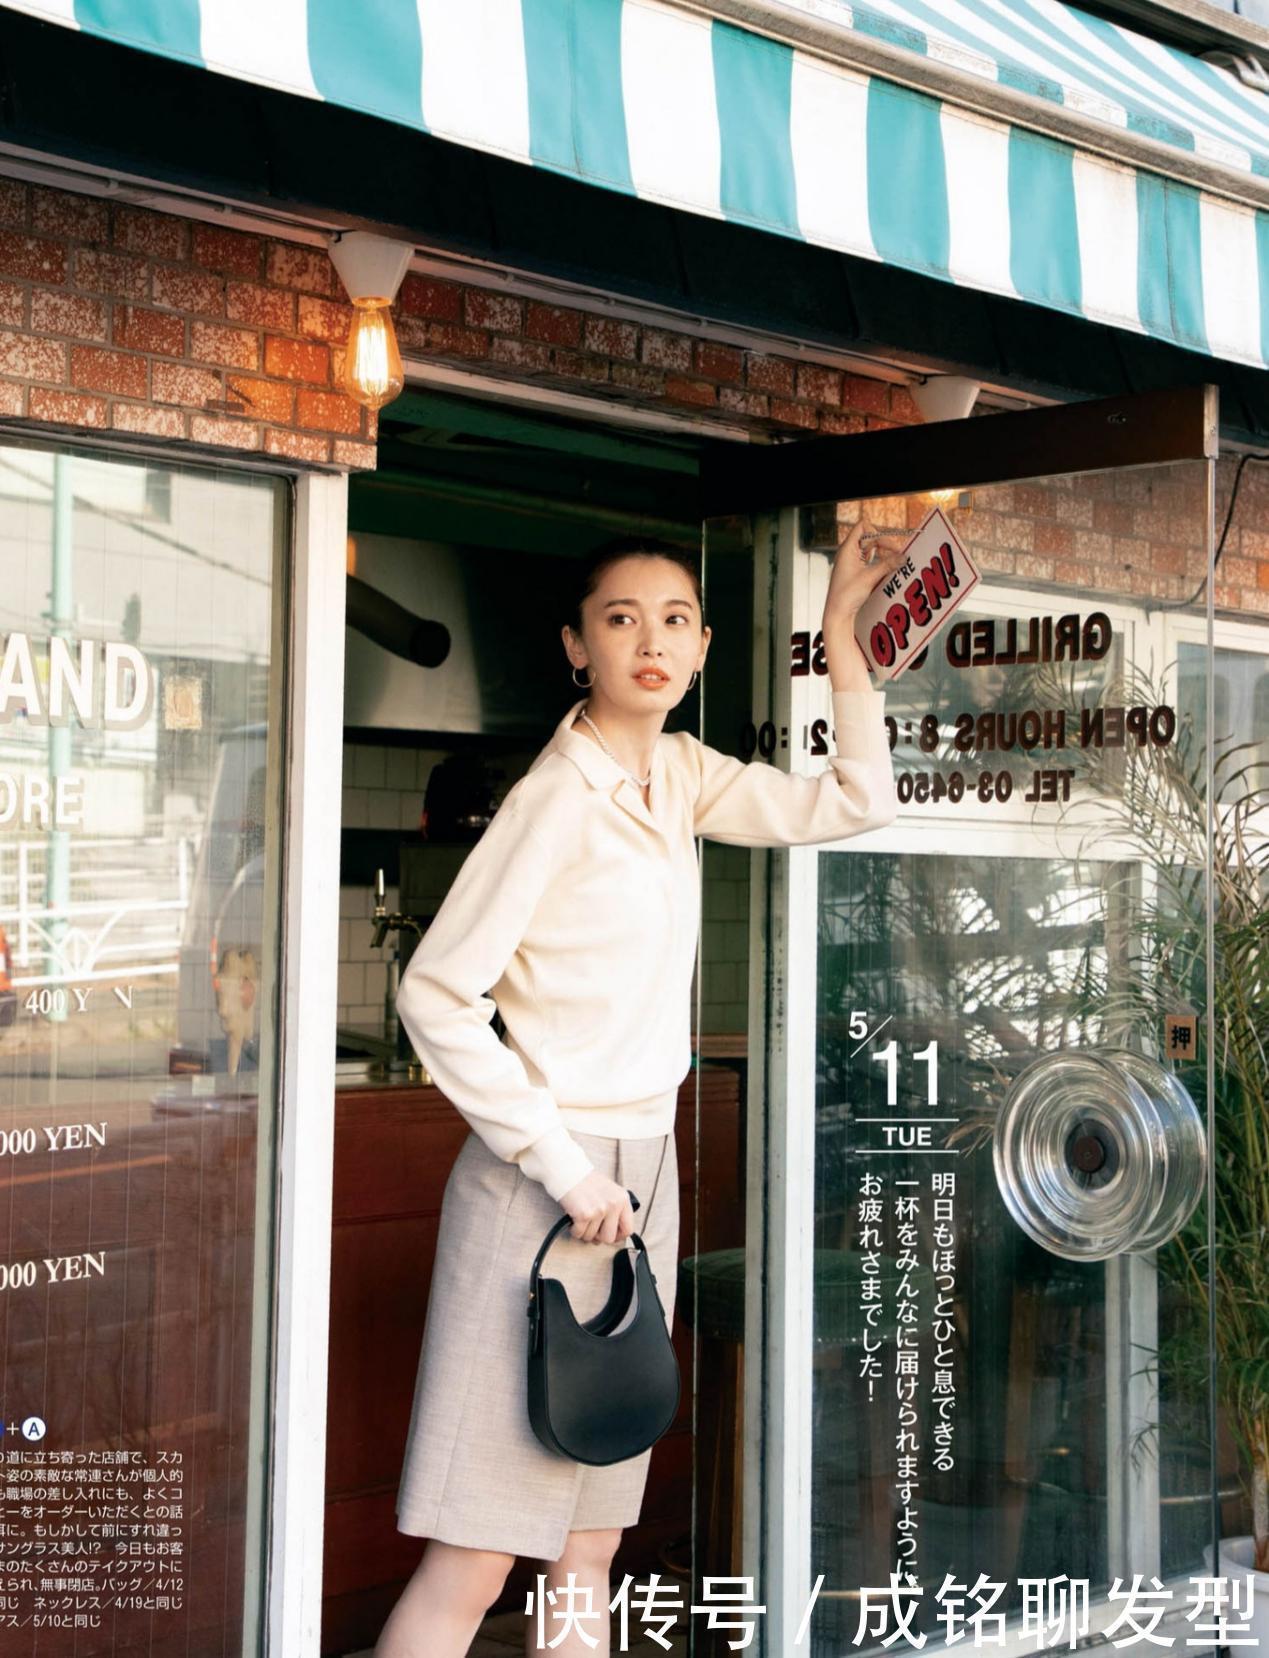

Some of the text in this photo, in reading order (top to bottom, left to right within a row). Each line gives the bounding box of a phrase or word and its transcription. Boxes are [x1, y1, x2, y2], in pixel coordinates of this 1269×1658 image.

[883, 557, 916, 599] WE'RE
[870, 542, 960, 667] OPEN!
[25, 989, 66, 1015] 400
[1171, 1024, 1192, 1050] 押
[43, 1122, 108, 1151] YEN
[43, 1252, 106, 1284] YEN
